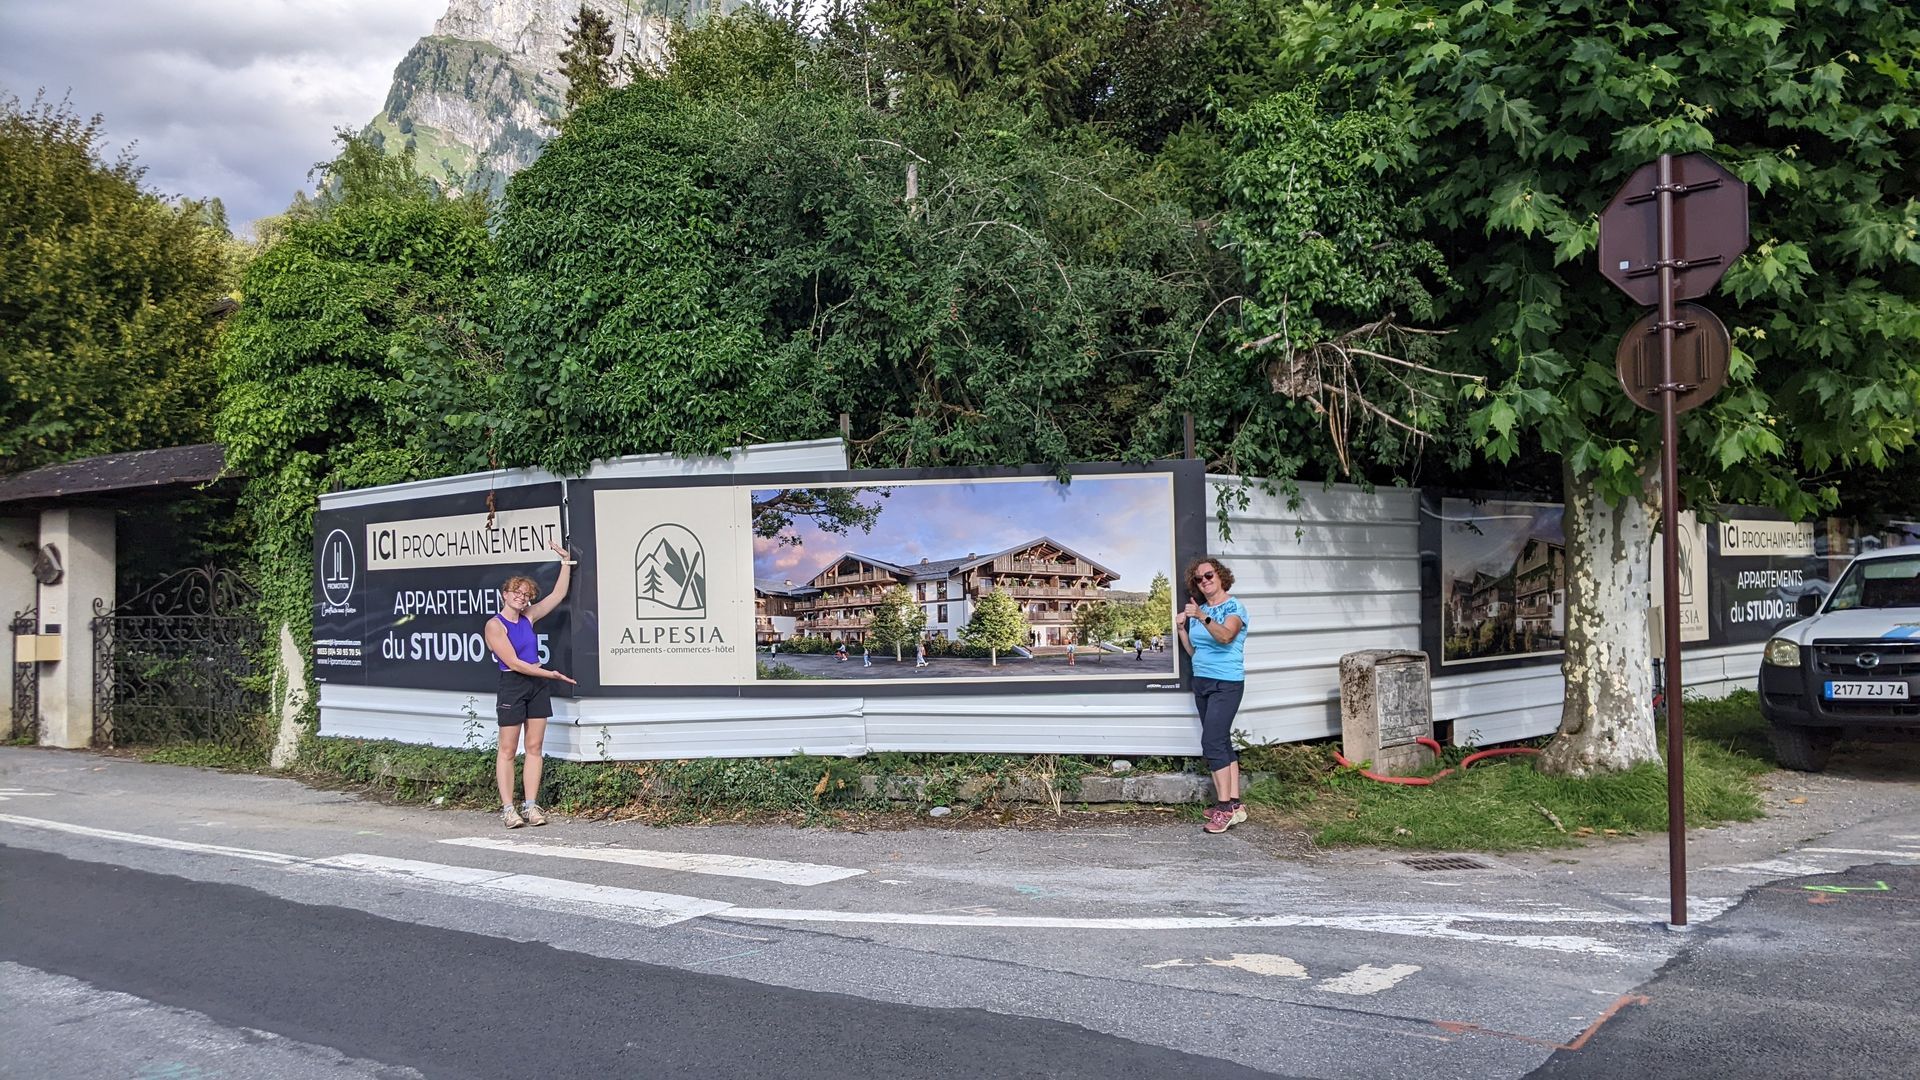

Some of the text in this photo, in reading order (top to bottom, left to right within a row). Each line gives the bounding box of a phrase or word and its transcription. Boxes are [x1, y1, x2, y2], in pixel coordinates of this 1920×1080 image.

[372, 529, 397, 561] ICI
[402, 524, 556, 559] PROCHAINEMENT
[1723, 525, 1813, 549] ICI PROCHAINEMENT
[1737, 569, 1803, 590] APPARTEMENTS
[393, 588, 505, 615] APPARTEMEN
[1730, 599, 1797, 623] du STUDIO au
[1680, 609, 1700, 624] ESIA
[382, 631, 405, 660] du
[410, 632, 485, 662] STUDIO
[620, 626, 725, 644] ALPESIA
[1834, 684, 1904, 696] 2177 ZJ 74
